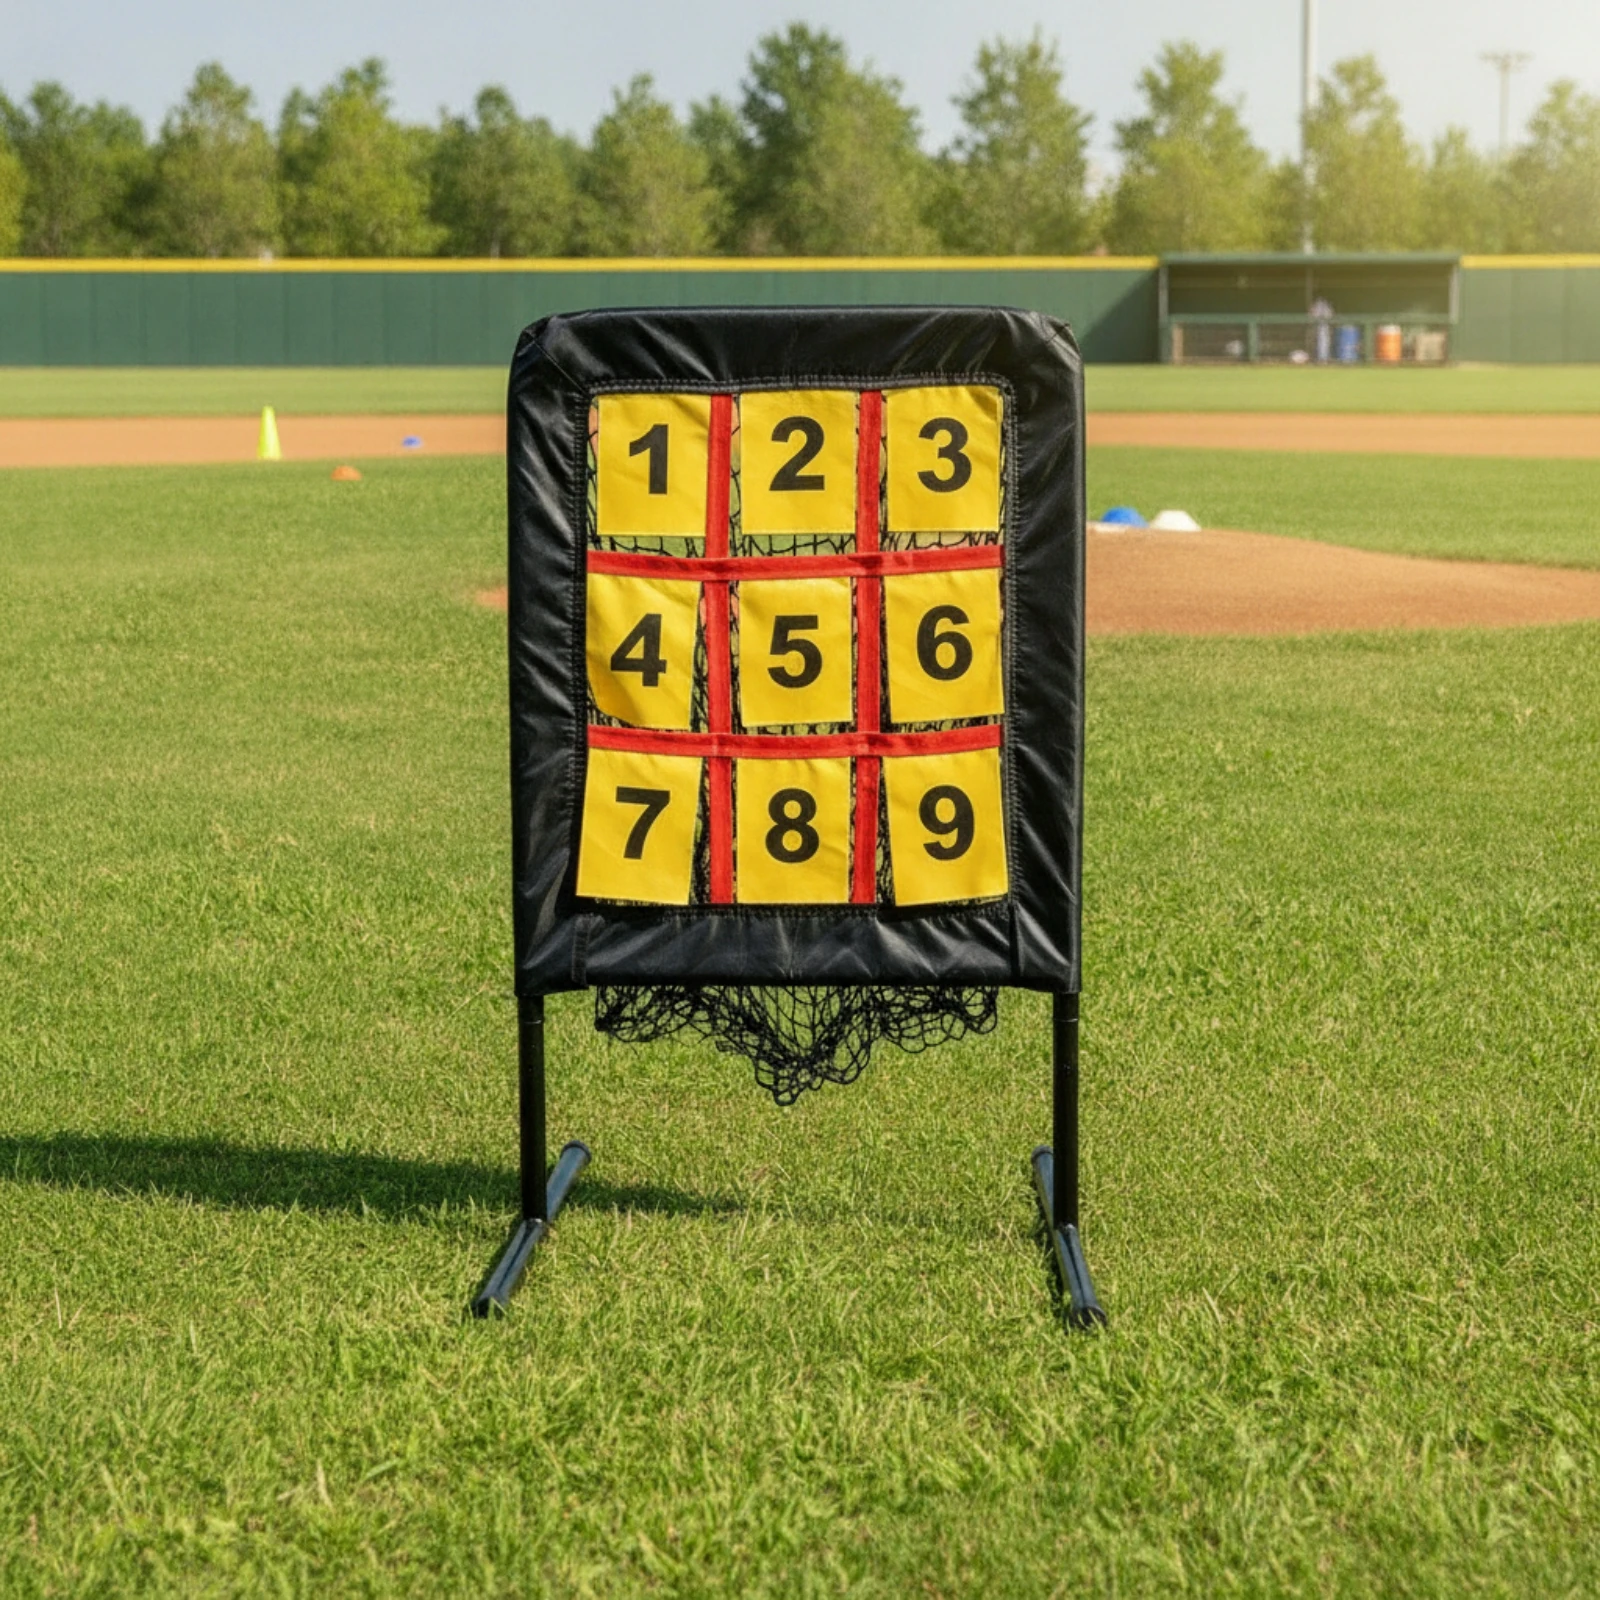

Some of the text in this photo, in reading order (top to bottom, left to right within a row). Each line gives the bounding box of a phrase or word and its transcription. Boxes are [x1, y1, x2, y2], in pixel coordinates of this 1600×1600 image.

[629, 424, 668, 494] 1
[770, 417, 825, 491] 2
[918, 418, 972, 493] 3
[609, 614, 667, 687] 4
[768, 615, 822, 689] 5
[917, 605, 973, 680] 6
[615, 787, 670, 860] 7
[765, 788, 820, 863] 8
[919, 785, 975, 861] 9
